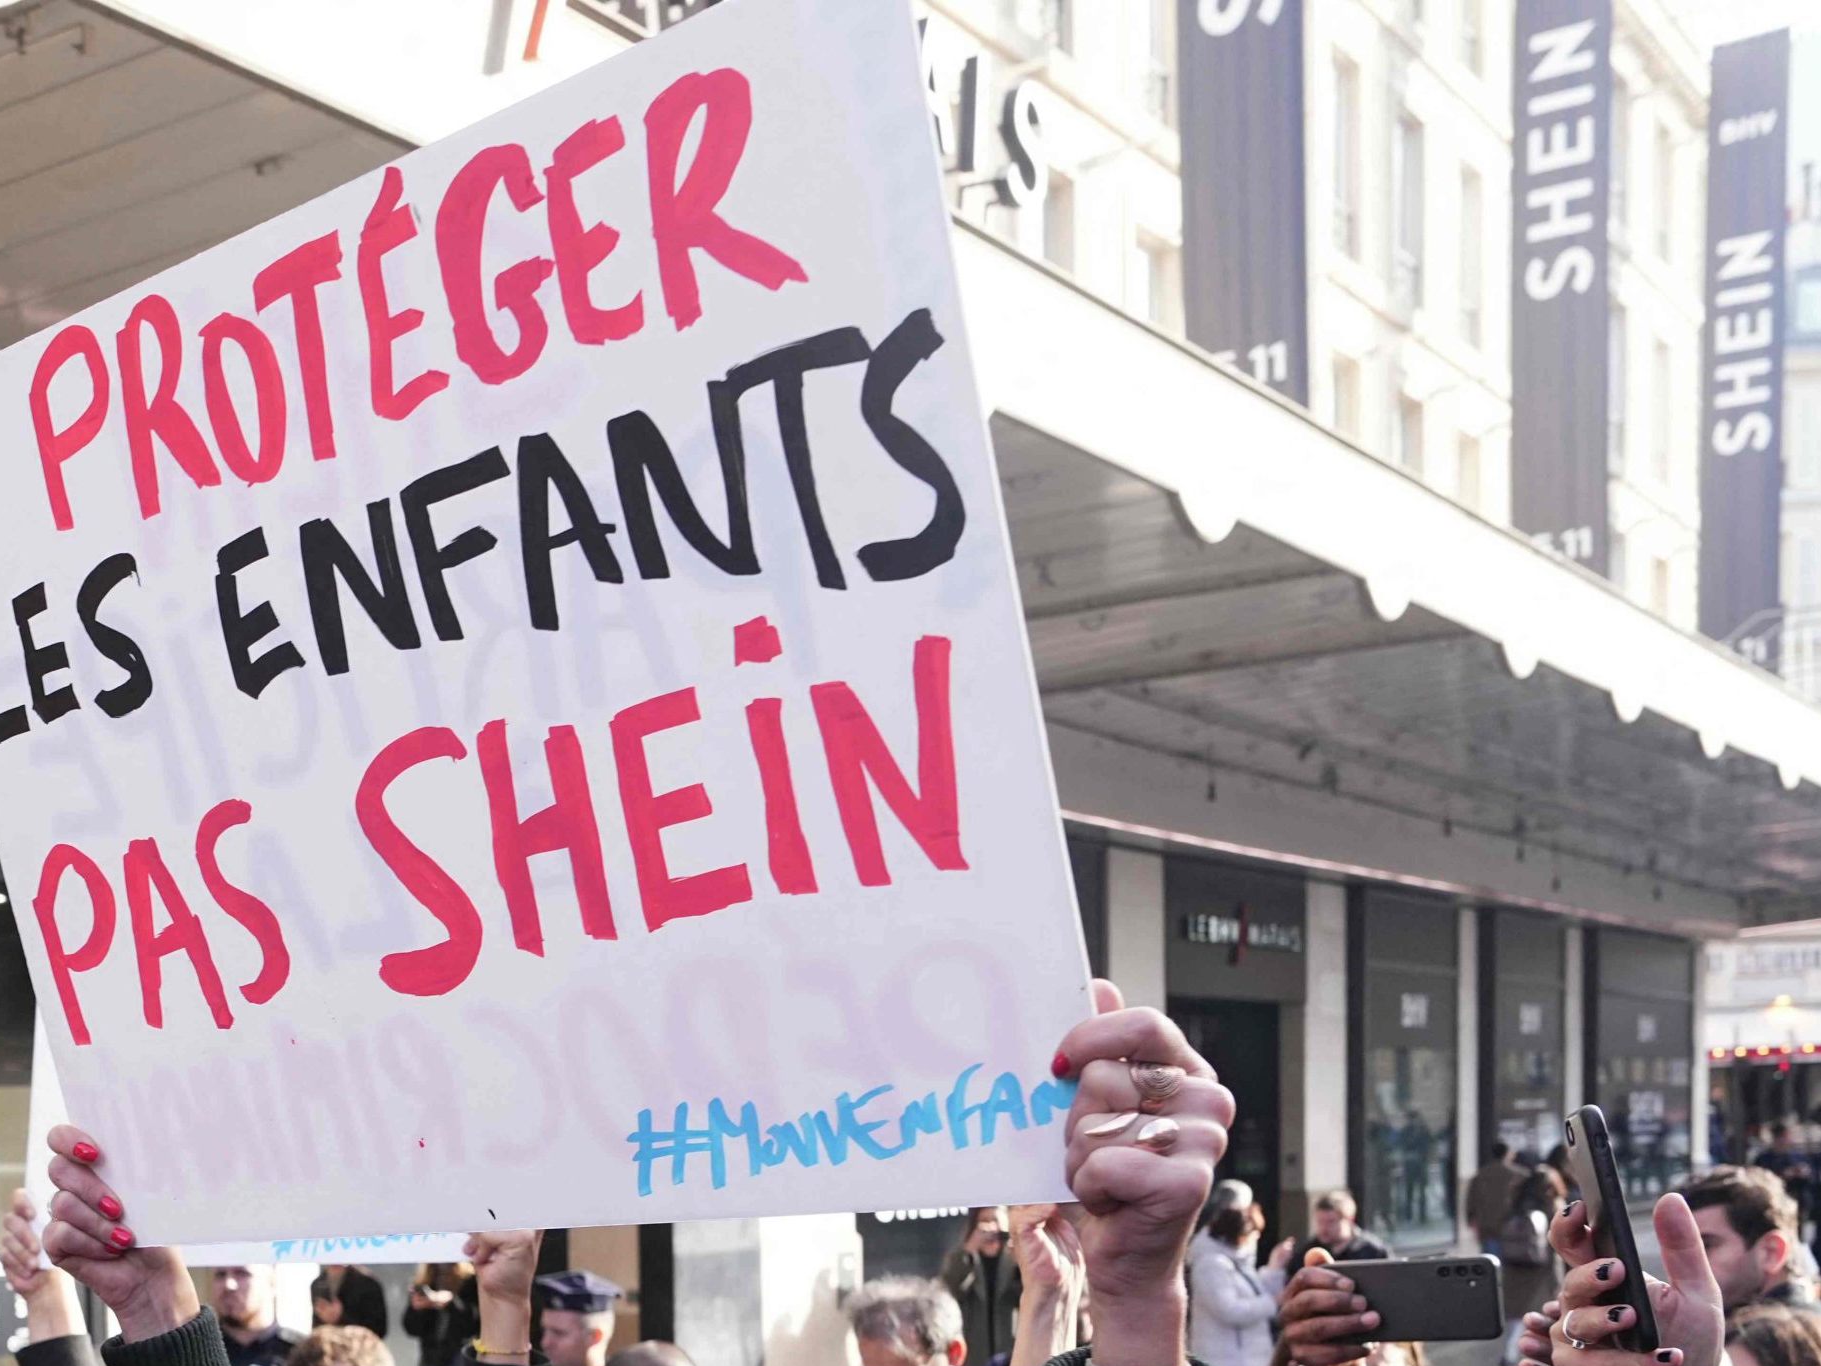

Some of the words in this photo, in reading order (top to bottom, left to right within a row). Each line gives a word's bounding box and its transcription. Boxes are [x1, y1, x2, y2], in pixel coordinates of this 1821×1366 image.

[29, 68, 807, 531] PROTÉGER
[1524, 18, 1596, 301] SHEIN
[1711, 230, 1775, 458] SHEIN
[216, 309, 966, 699] ENFANTS
[33, 799, 290, 1045] PAS
